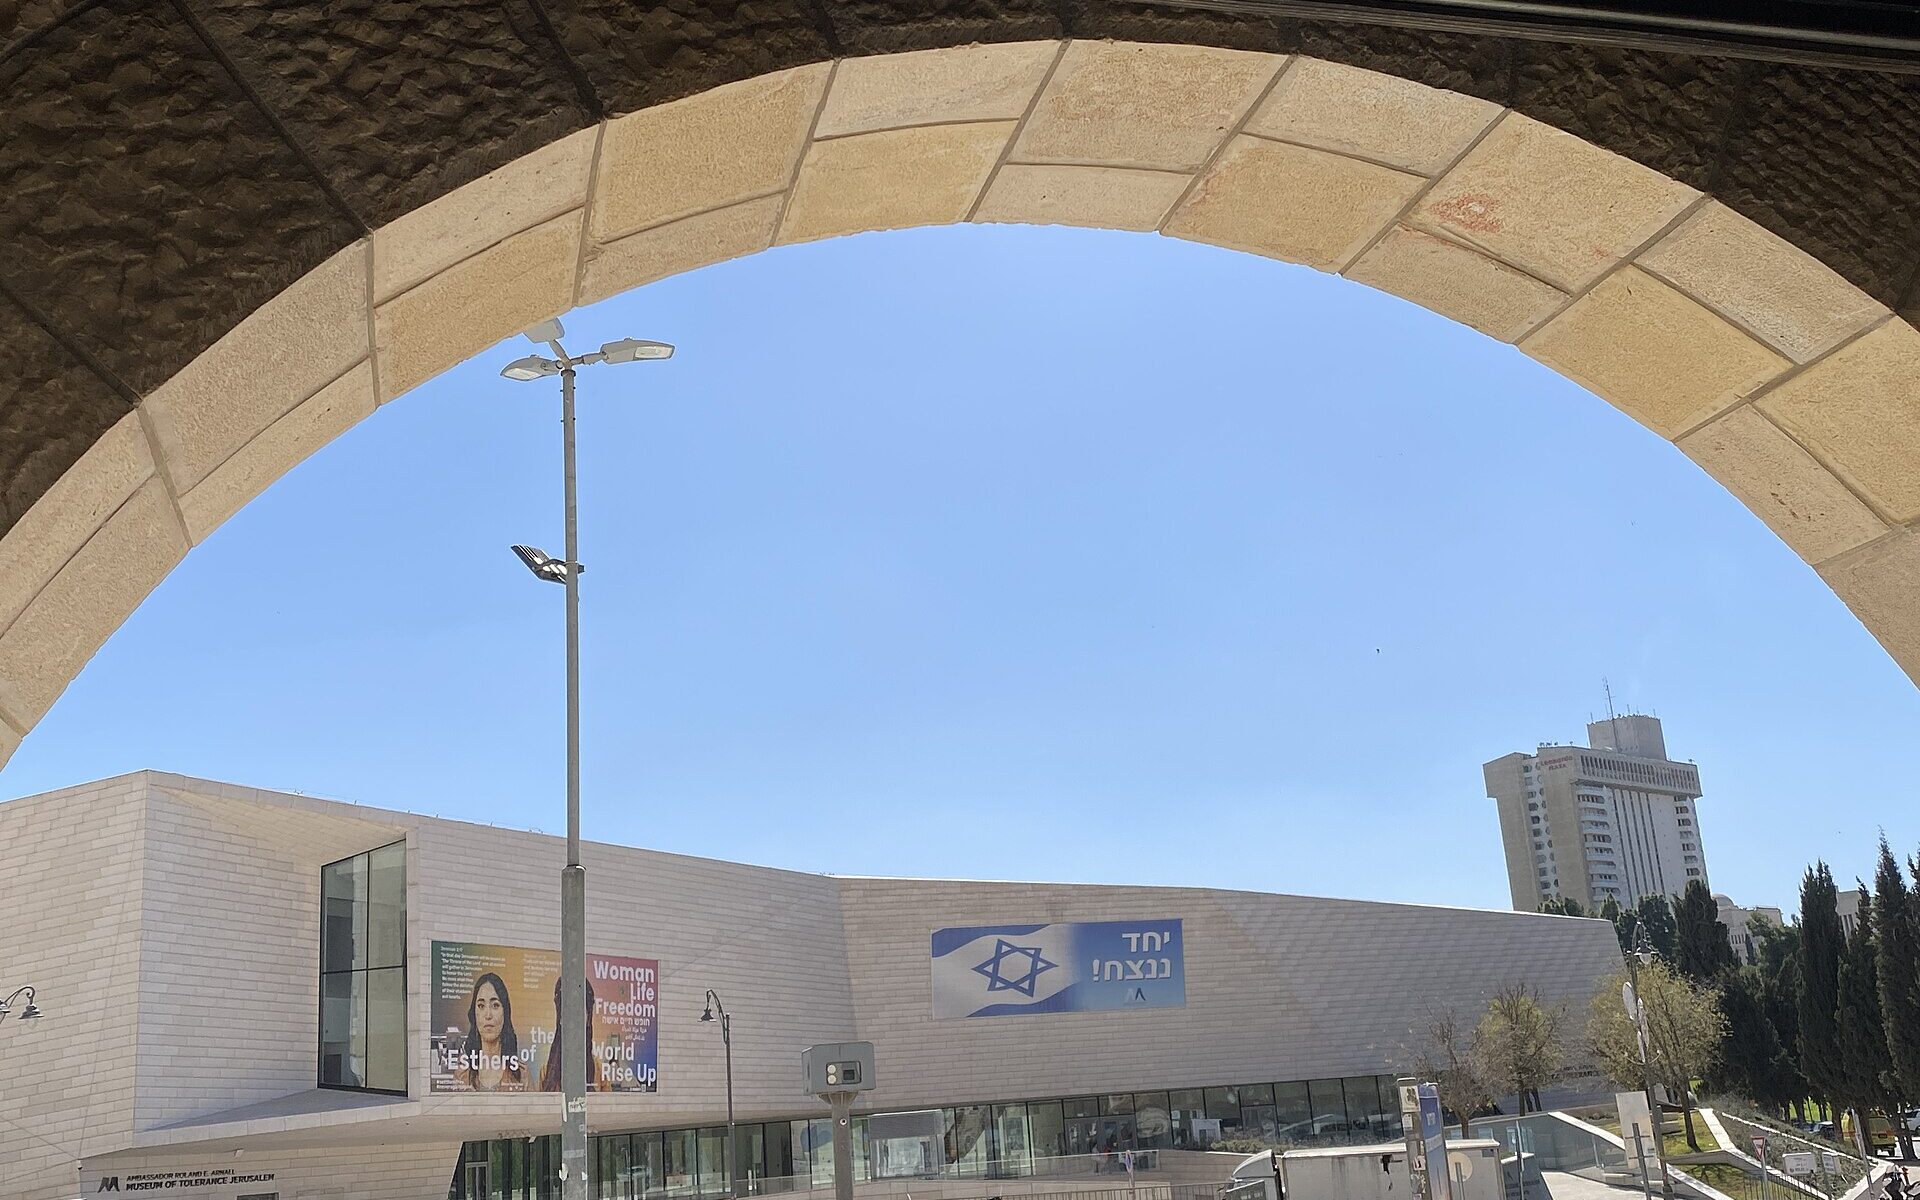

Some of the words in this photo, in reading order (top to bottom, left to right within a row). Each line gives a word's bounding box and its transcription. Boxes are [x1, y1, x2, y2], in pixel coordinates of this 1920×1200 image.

[1122, 931, 1170, 953] יחד
[593, 960, 655, 983] Woman
[1093, 958, 1171, 982] ננצח!
[630, 981, 655, 1002] Life
[594, 997, 656, 1018] Freedom
[530, 1027, 555, 1045] the
[448, 1048, 519, 1072] Esthers
[520, 1043, 537, 1064] of
[592, 1041, 635, 1062] World
[601, 1062, 633, 1082] Rise
[637, 1063, 657, 1087] Up
[126, 1173, 173, 1182] AMBASSADOR
[174, 1171, 202, 1180] ROLAND
[126, 1180, 163, 1191] MUSEUM
[164, 1179, 176, 1189] OF
[178, 1176, 227, 1188] TOLERANCE
[229, 1173, 275, 1184] JERUSALEM
